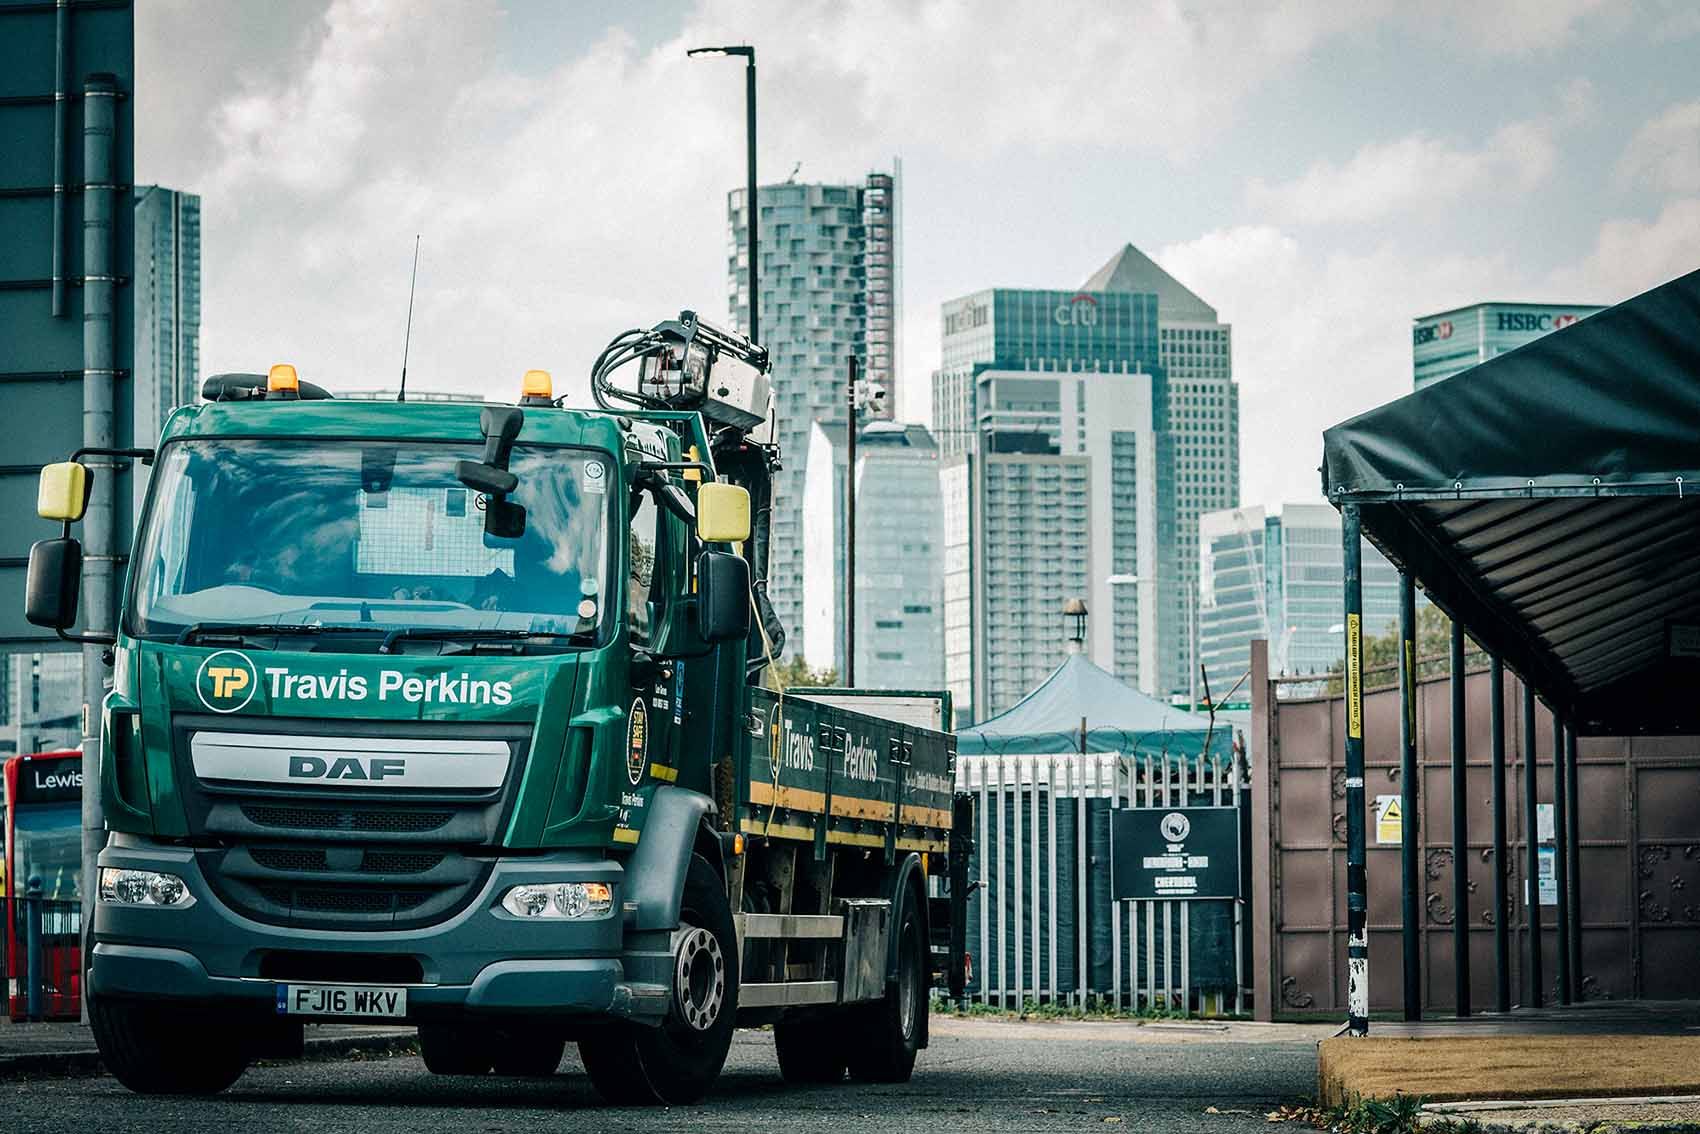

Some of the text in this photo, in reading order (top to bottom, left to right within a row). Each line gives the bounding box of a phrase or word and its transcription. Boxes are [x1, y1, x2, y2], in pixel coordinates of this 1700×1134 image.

[1055, 295, 1097, 326] citi
[1498, 312, 1552, 331] HSBC
[207, 667, 249, 698] TP
[265, 667, 512, 706] Travis Perkins
[784, 719, 814, 772] Travis
[843, 732, 878, 783] Perkins
[288, 756, 406, 780] DAF
[296, 989, 398, 1014] FJ16 WKV
